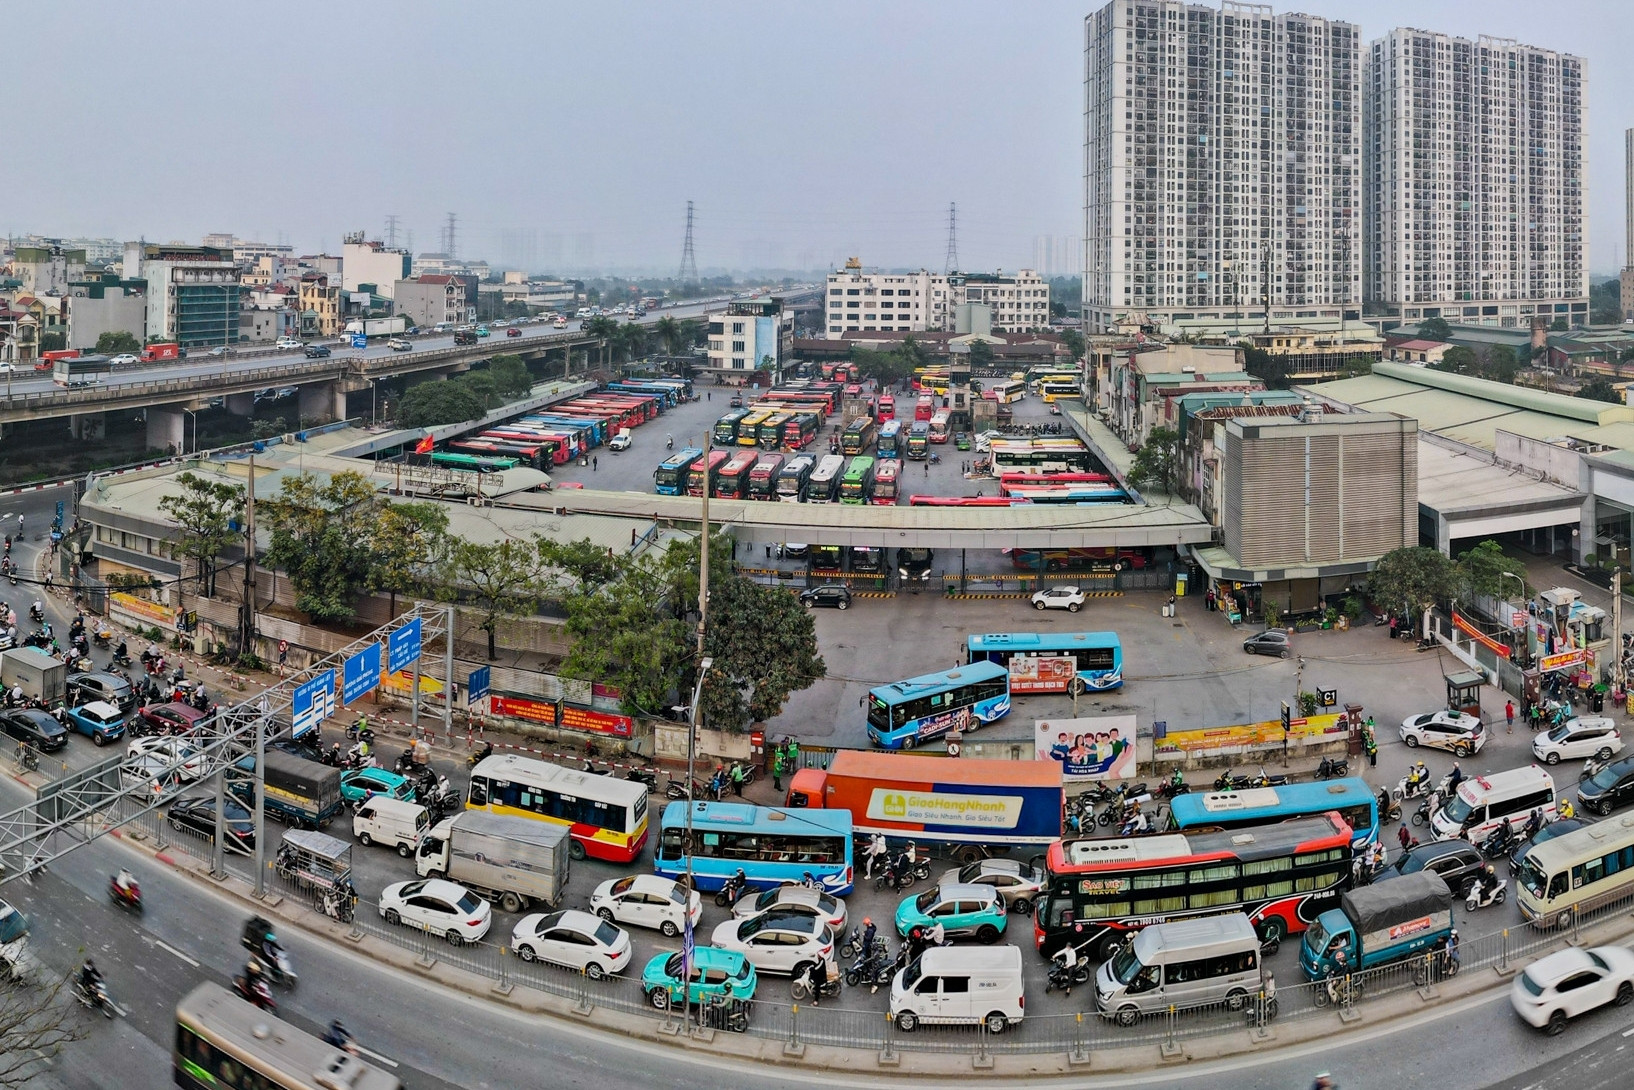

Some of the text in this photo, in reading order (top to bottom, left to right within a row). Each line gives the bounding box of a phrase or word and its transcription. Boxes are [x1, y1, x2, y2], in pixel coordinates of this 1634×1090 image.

[1324, 692, 1335, 700] C1
[908, 796, 1006, 813] GiaoHangNhanh
[907, 810, 923, 818] Giao
[924, 811, 939, 819] Siêu
[1082, 879, 1103, 890] SAO
